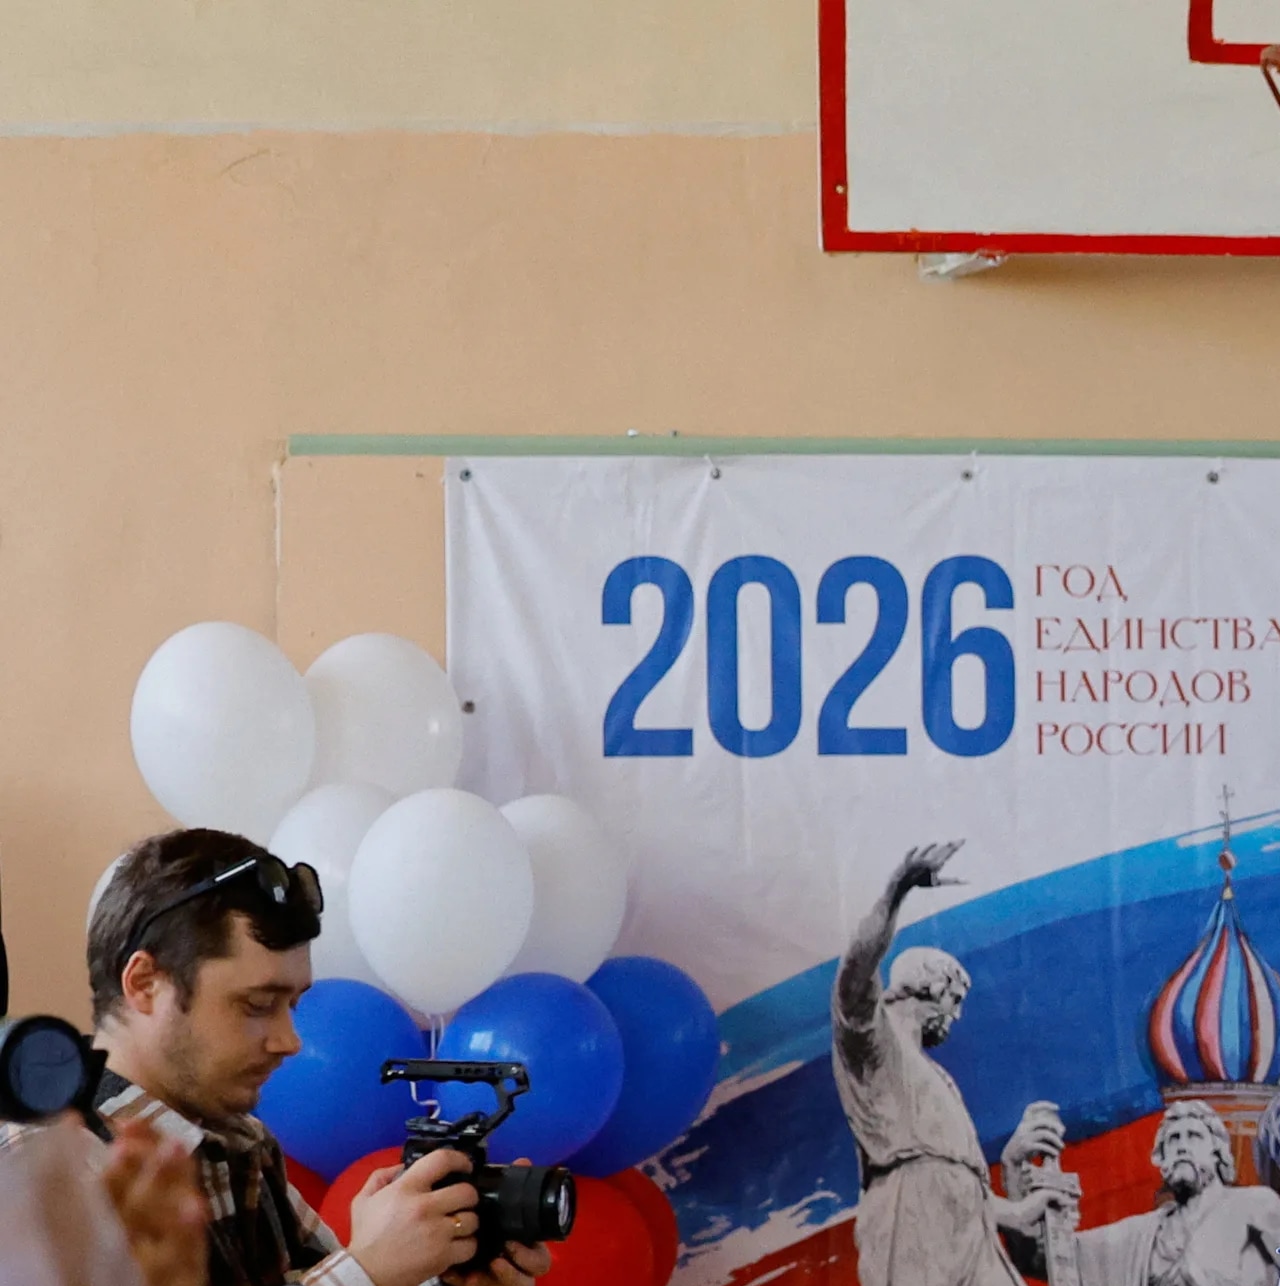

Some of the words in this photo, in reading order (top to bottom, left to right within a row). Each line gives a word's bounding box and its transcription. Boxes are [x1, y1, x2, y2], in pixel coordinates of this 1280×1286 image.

[1035, 564, 1129, 603] ГОД
[601, 555, 1016, 758] 2026
[1035, 669, 1252, 708] НАРОДОВ
[1035, 721, 1229, 757] РОССИИ
